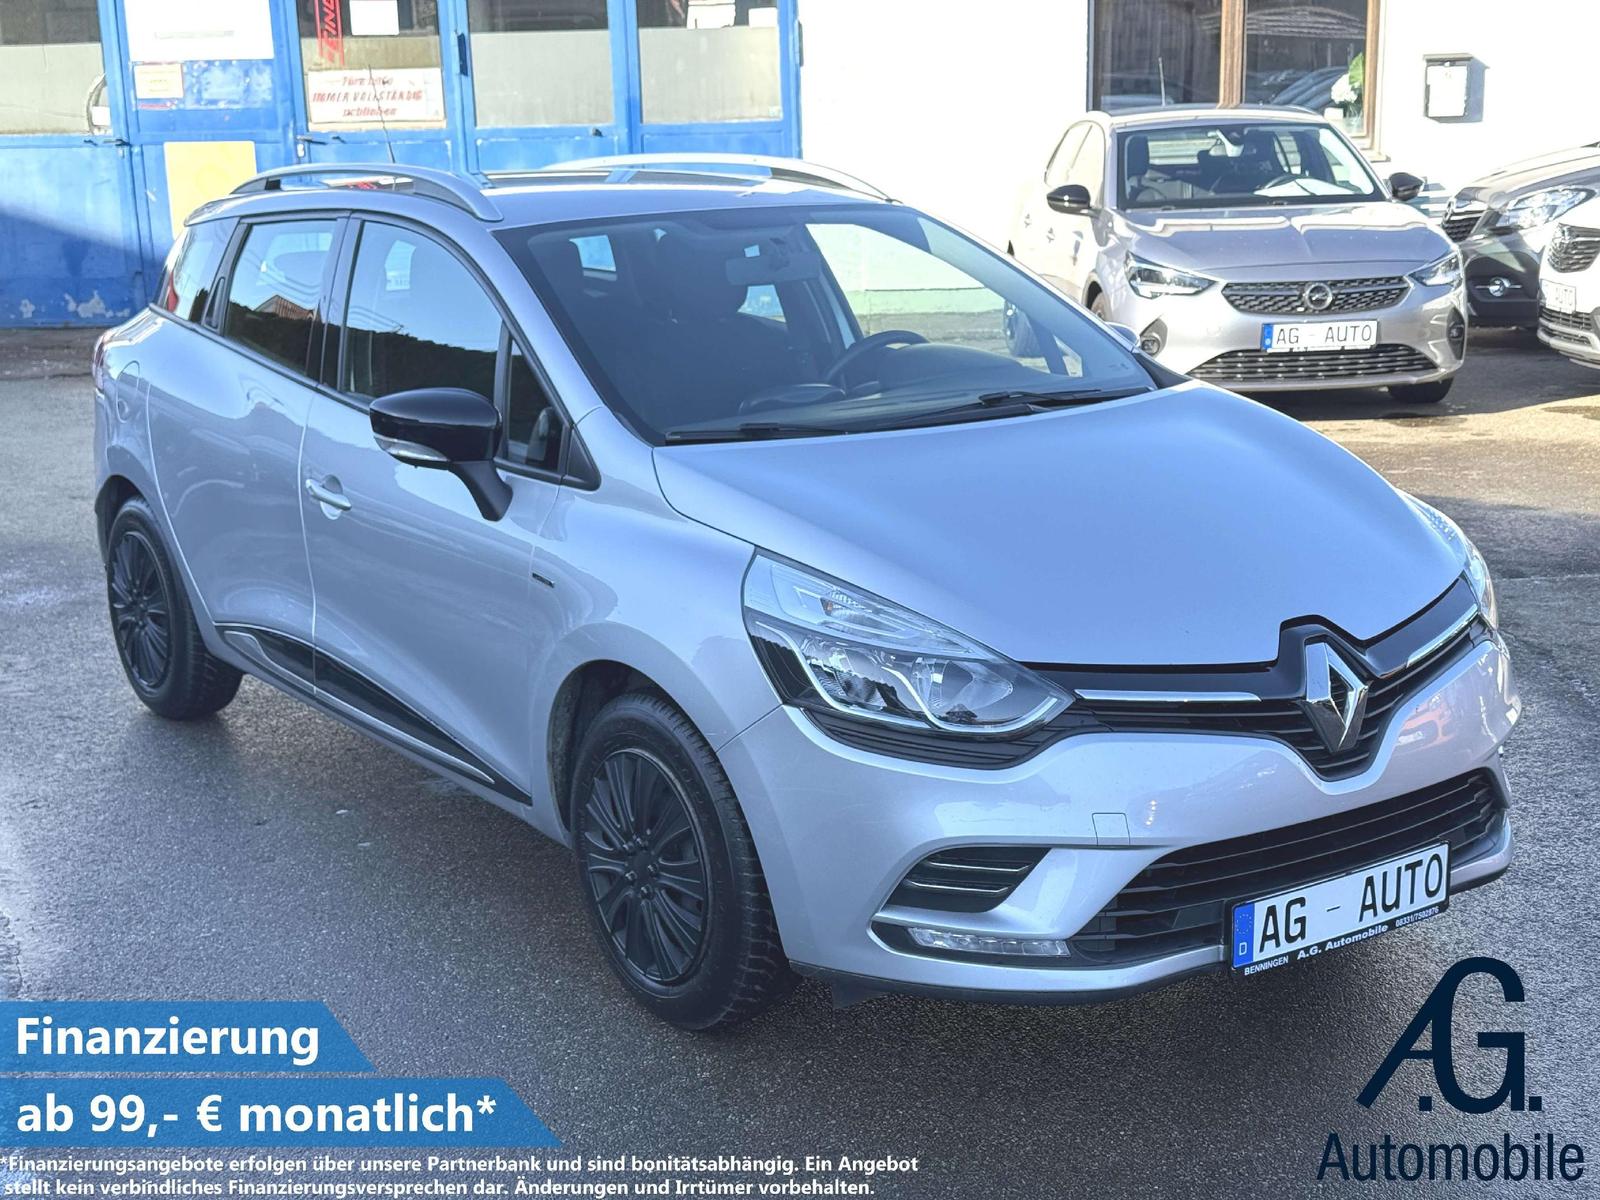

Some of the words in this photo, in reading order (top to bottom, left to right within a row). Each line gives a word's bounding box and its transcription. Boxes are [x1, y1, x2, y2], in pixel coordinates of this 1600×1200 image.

[1276, 328, 1299, 344] AG
[1325, 324, 1372, 343] AUTO
[1259, 896, 1307, 953] AG
[1358, 853, 1444, 922] AUTO
[1244, 955, 1289, 976] BENNINGEN
[1296, 946, 1322, 960] A.G.
[1325, 923, 1389, 951] Automobile
